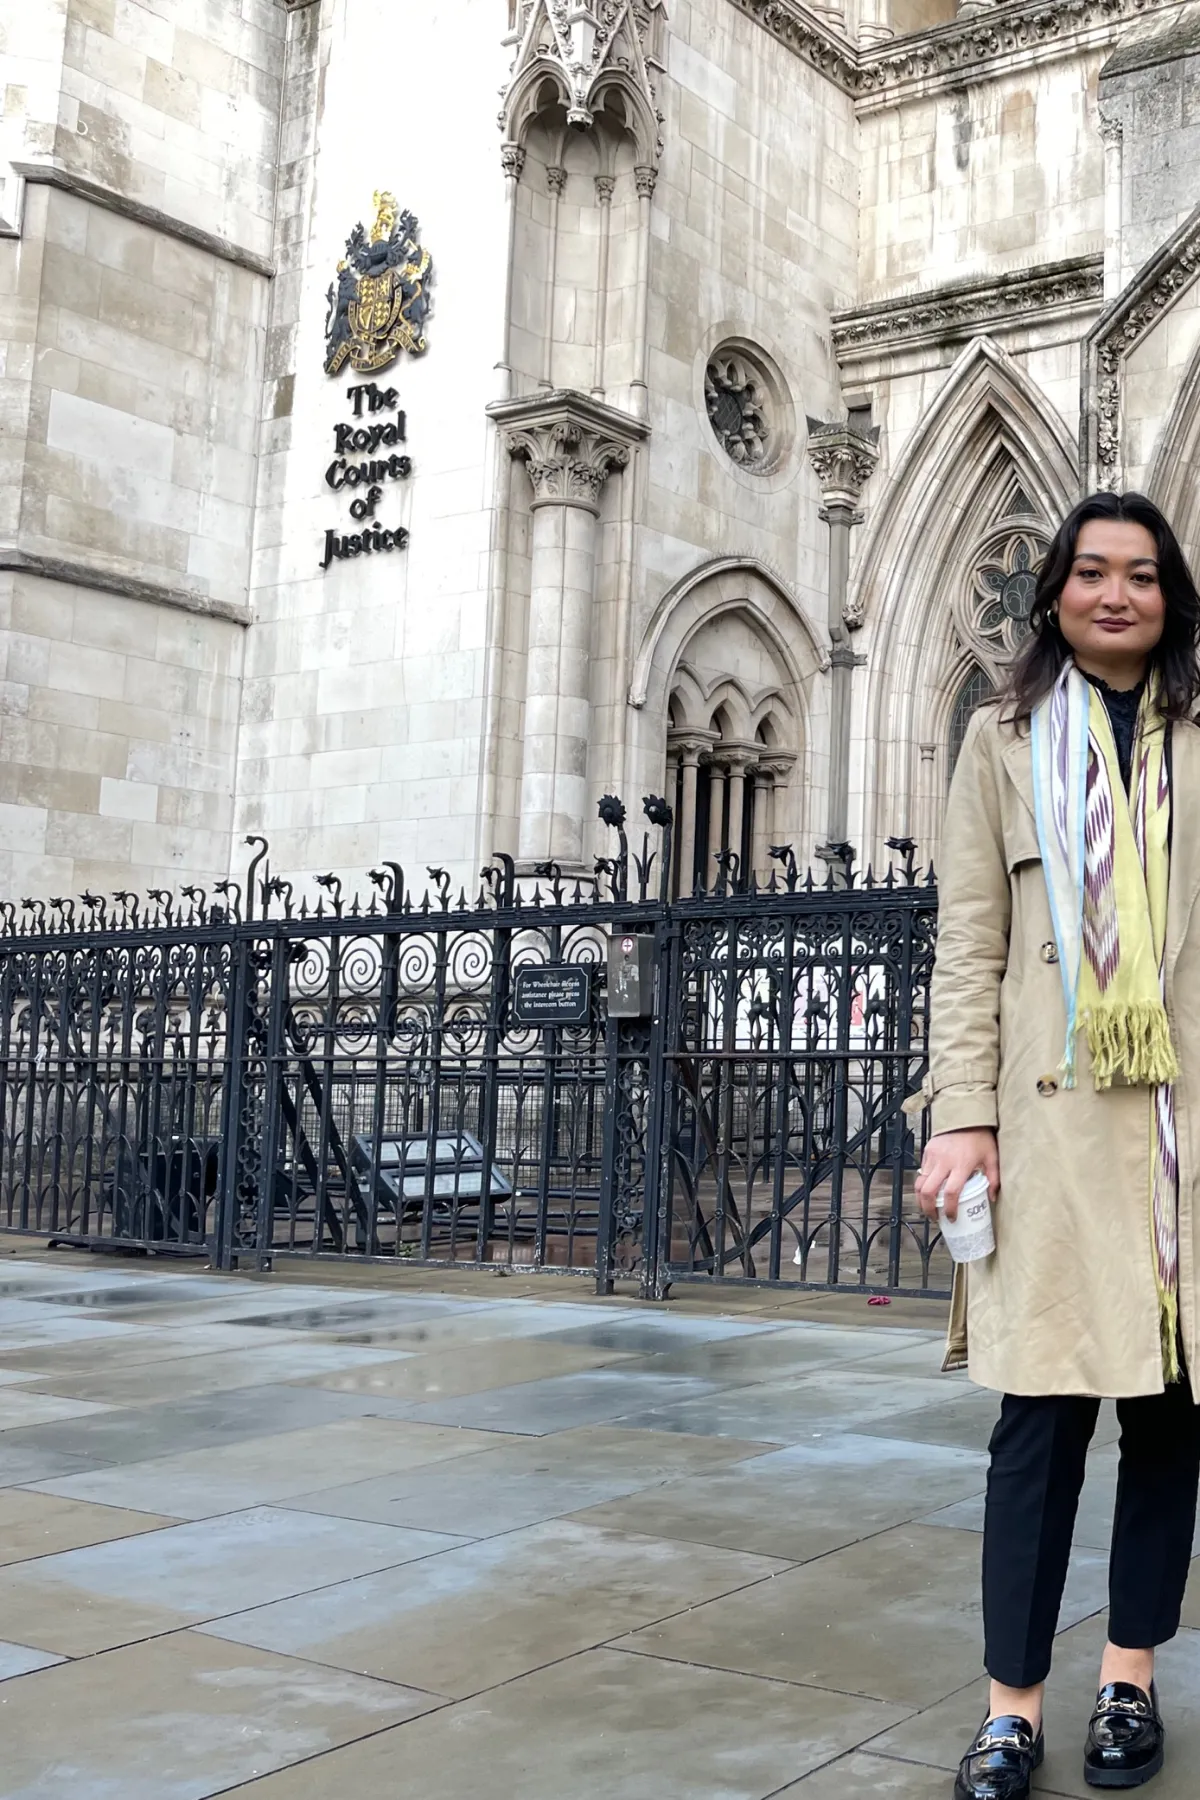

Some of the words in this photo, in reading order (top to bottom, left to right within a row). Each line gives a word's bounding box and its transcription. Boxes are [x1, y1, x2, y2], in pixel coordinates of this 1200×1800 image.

[346, 382, 400, 415] The
[333, 410, 407, 454] Royal
[325, 453, 413, 490] Courts
[349, 485, 382, 520] of
[318, 521, 409, 570] Justice
